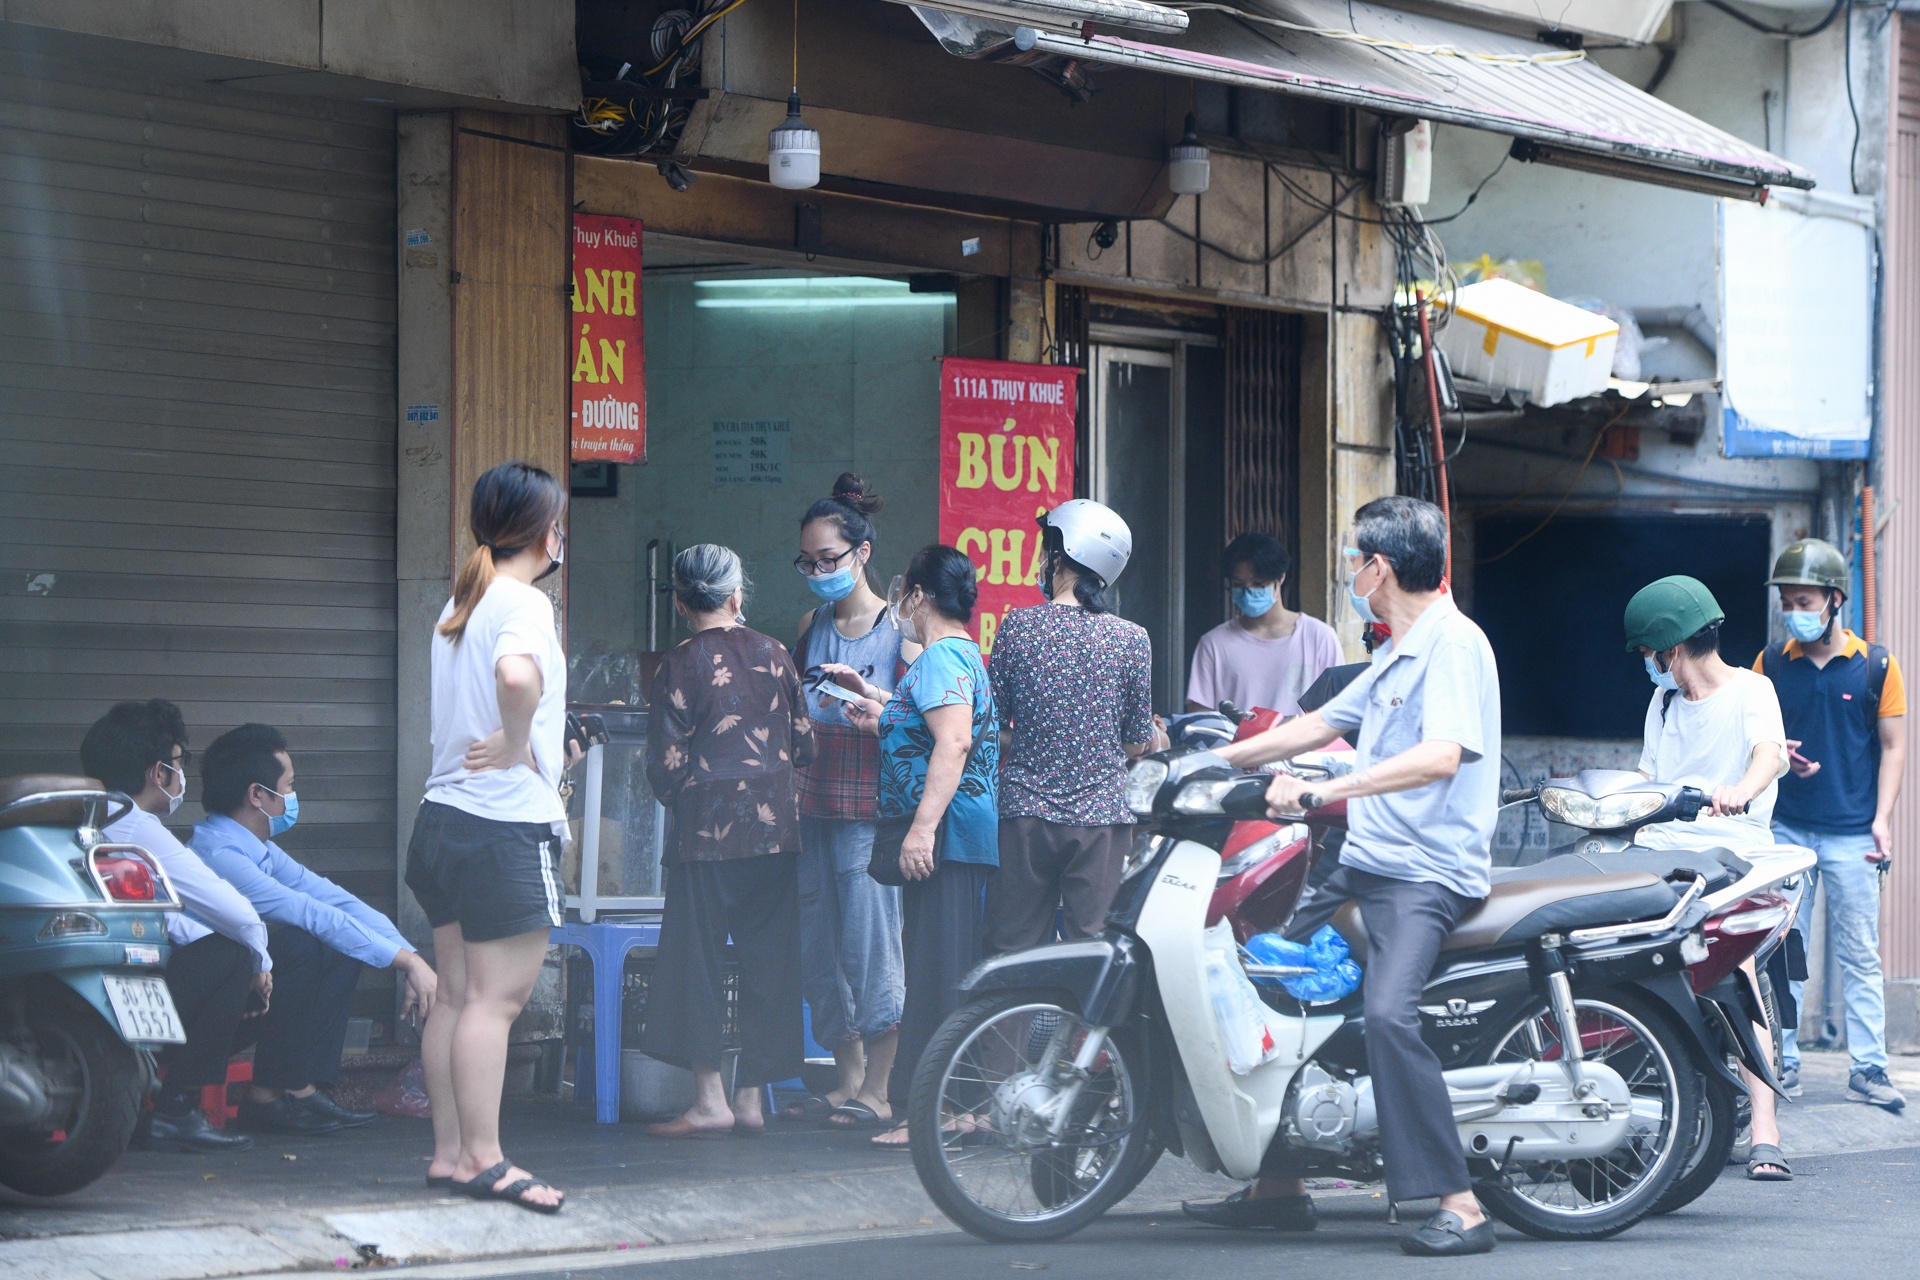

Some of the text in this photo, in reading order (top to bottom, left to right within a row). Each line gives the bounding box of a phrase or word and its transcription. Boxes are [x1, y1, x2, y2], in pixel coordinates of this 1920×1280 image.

[604, 229, 638, 248] Khuê
[953, 377, 1064, 405] 111A THỤY KHUÊ
[582, 394, 639, 430] ĐƯỜNG
[750, 436, 767, 446] 50K
[750, 449, 767, 459] 50K
[956, 418, 1060, 493] BÚN
[128, 1010, 176, 1038] 1552
